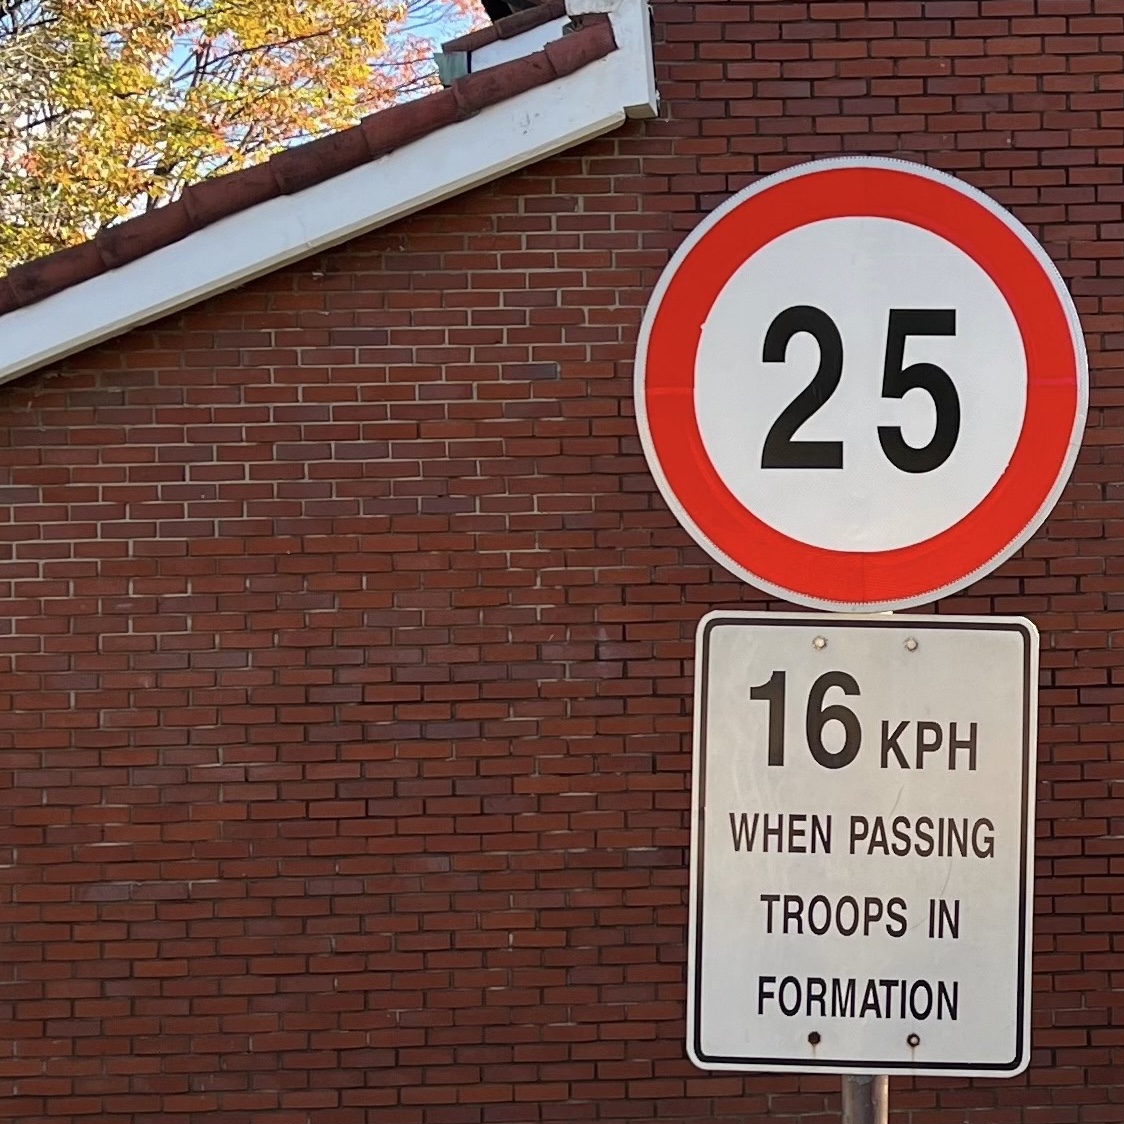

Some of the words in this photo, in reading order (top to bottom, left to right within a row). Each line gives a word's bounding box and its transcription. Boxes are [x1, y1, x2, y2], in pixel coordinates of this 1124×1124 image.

[759, 304, 962, 475] 25
[748, 670, 863, 770] 16
[879, 720, 979, 771] KPH
[728, 812, 833, 854] WHEN
[848, 815, 996, 859] PASSING
[759, 893, 909, 938] TROOPS
[927, 898, 961, 939] IN
[756, 975, 960, 1021] FORMATION
